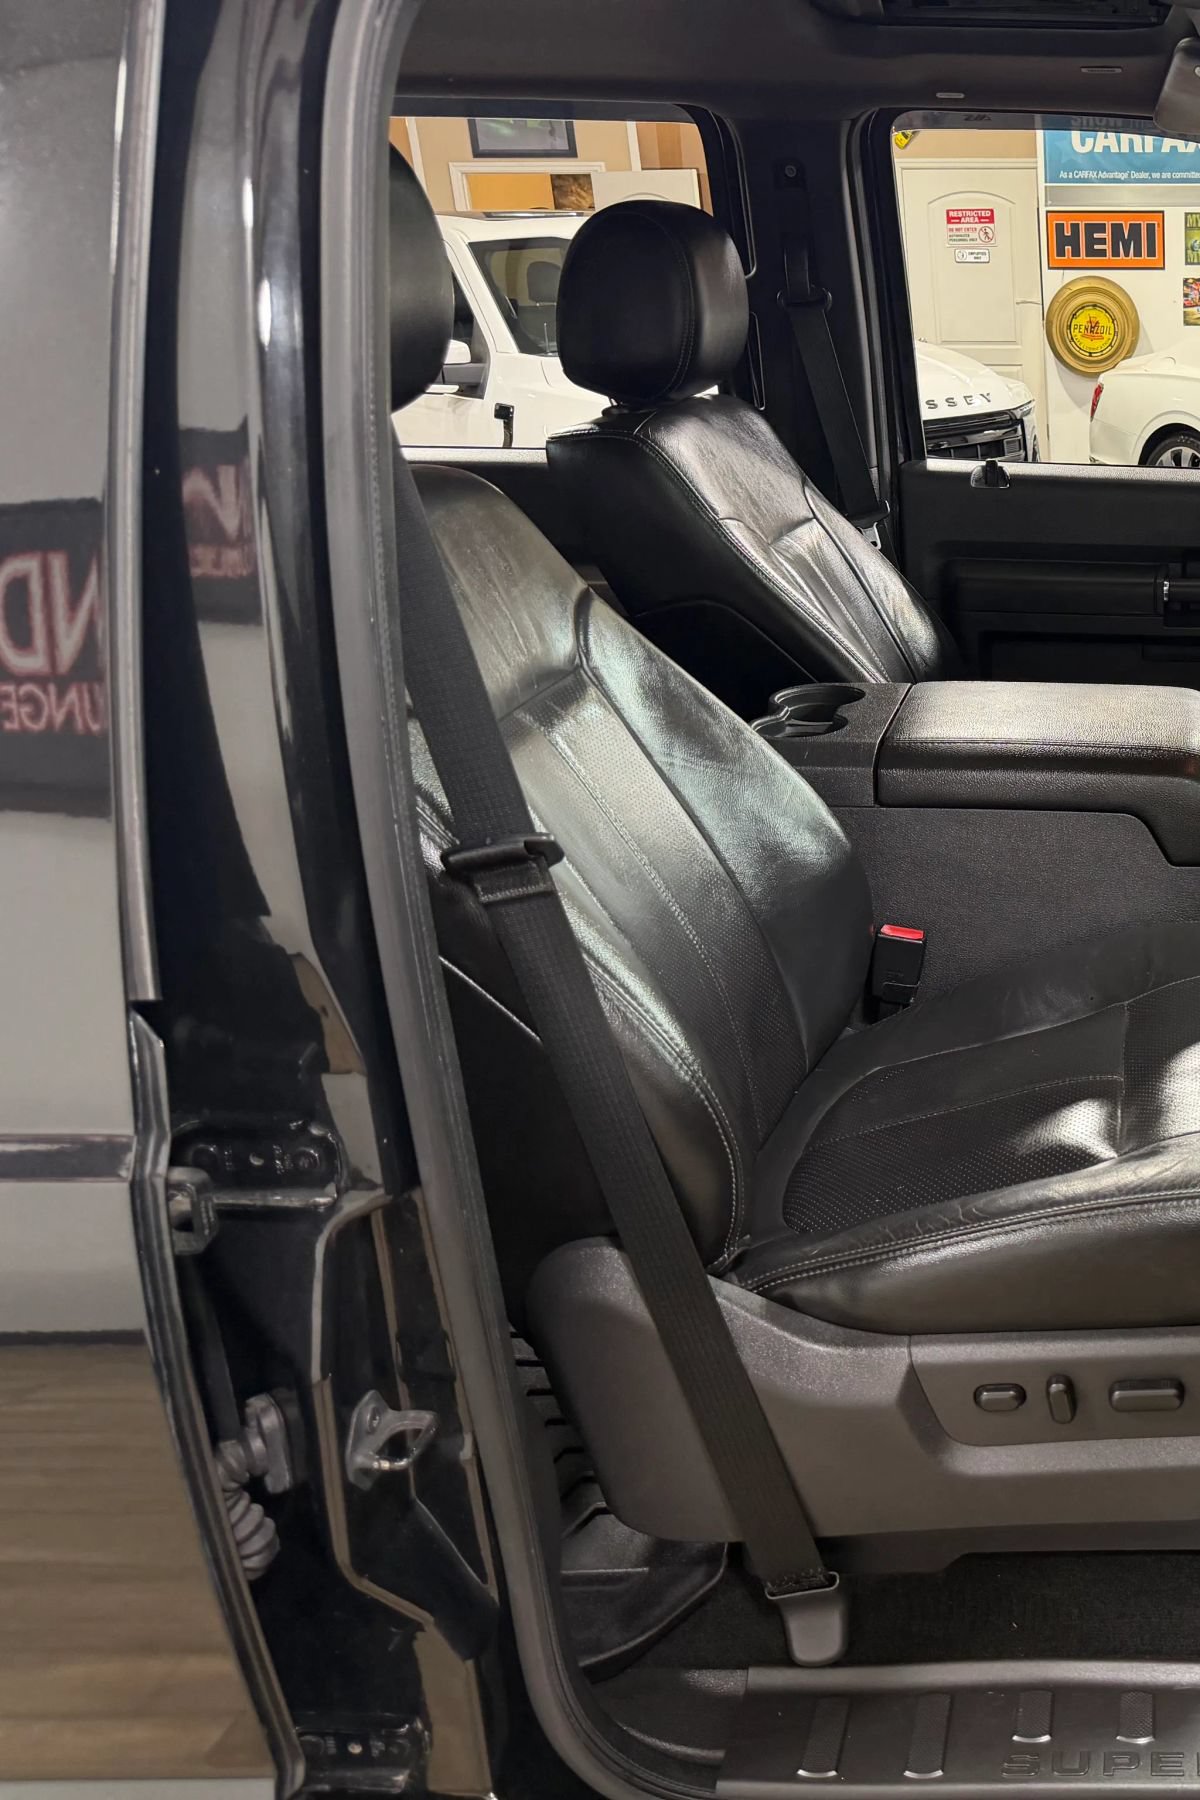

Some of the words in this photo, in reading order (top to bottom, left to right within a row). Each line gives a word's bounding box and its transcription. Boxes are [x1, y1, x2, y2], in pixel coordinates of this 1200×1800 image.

[1059, 170, 1068, 179] As
[1073, 170, 1098, 179] CARFAX
[1130, 170, 1151, 180] Dealer,
[1054, 221, 1158, 259] HEMI
[925, 392, 992, 410] SSEY
